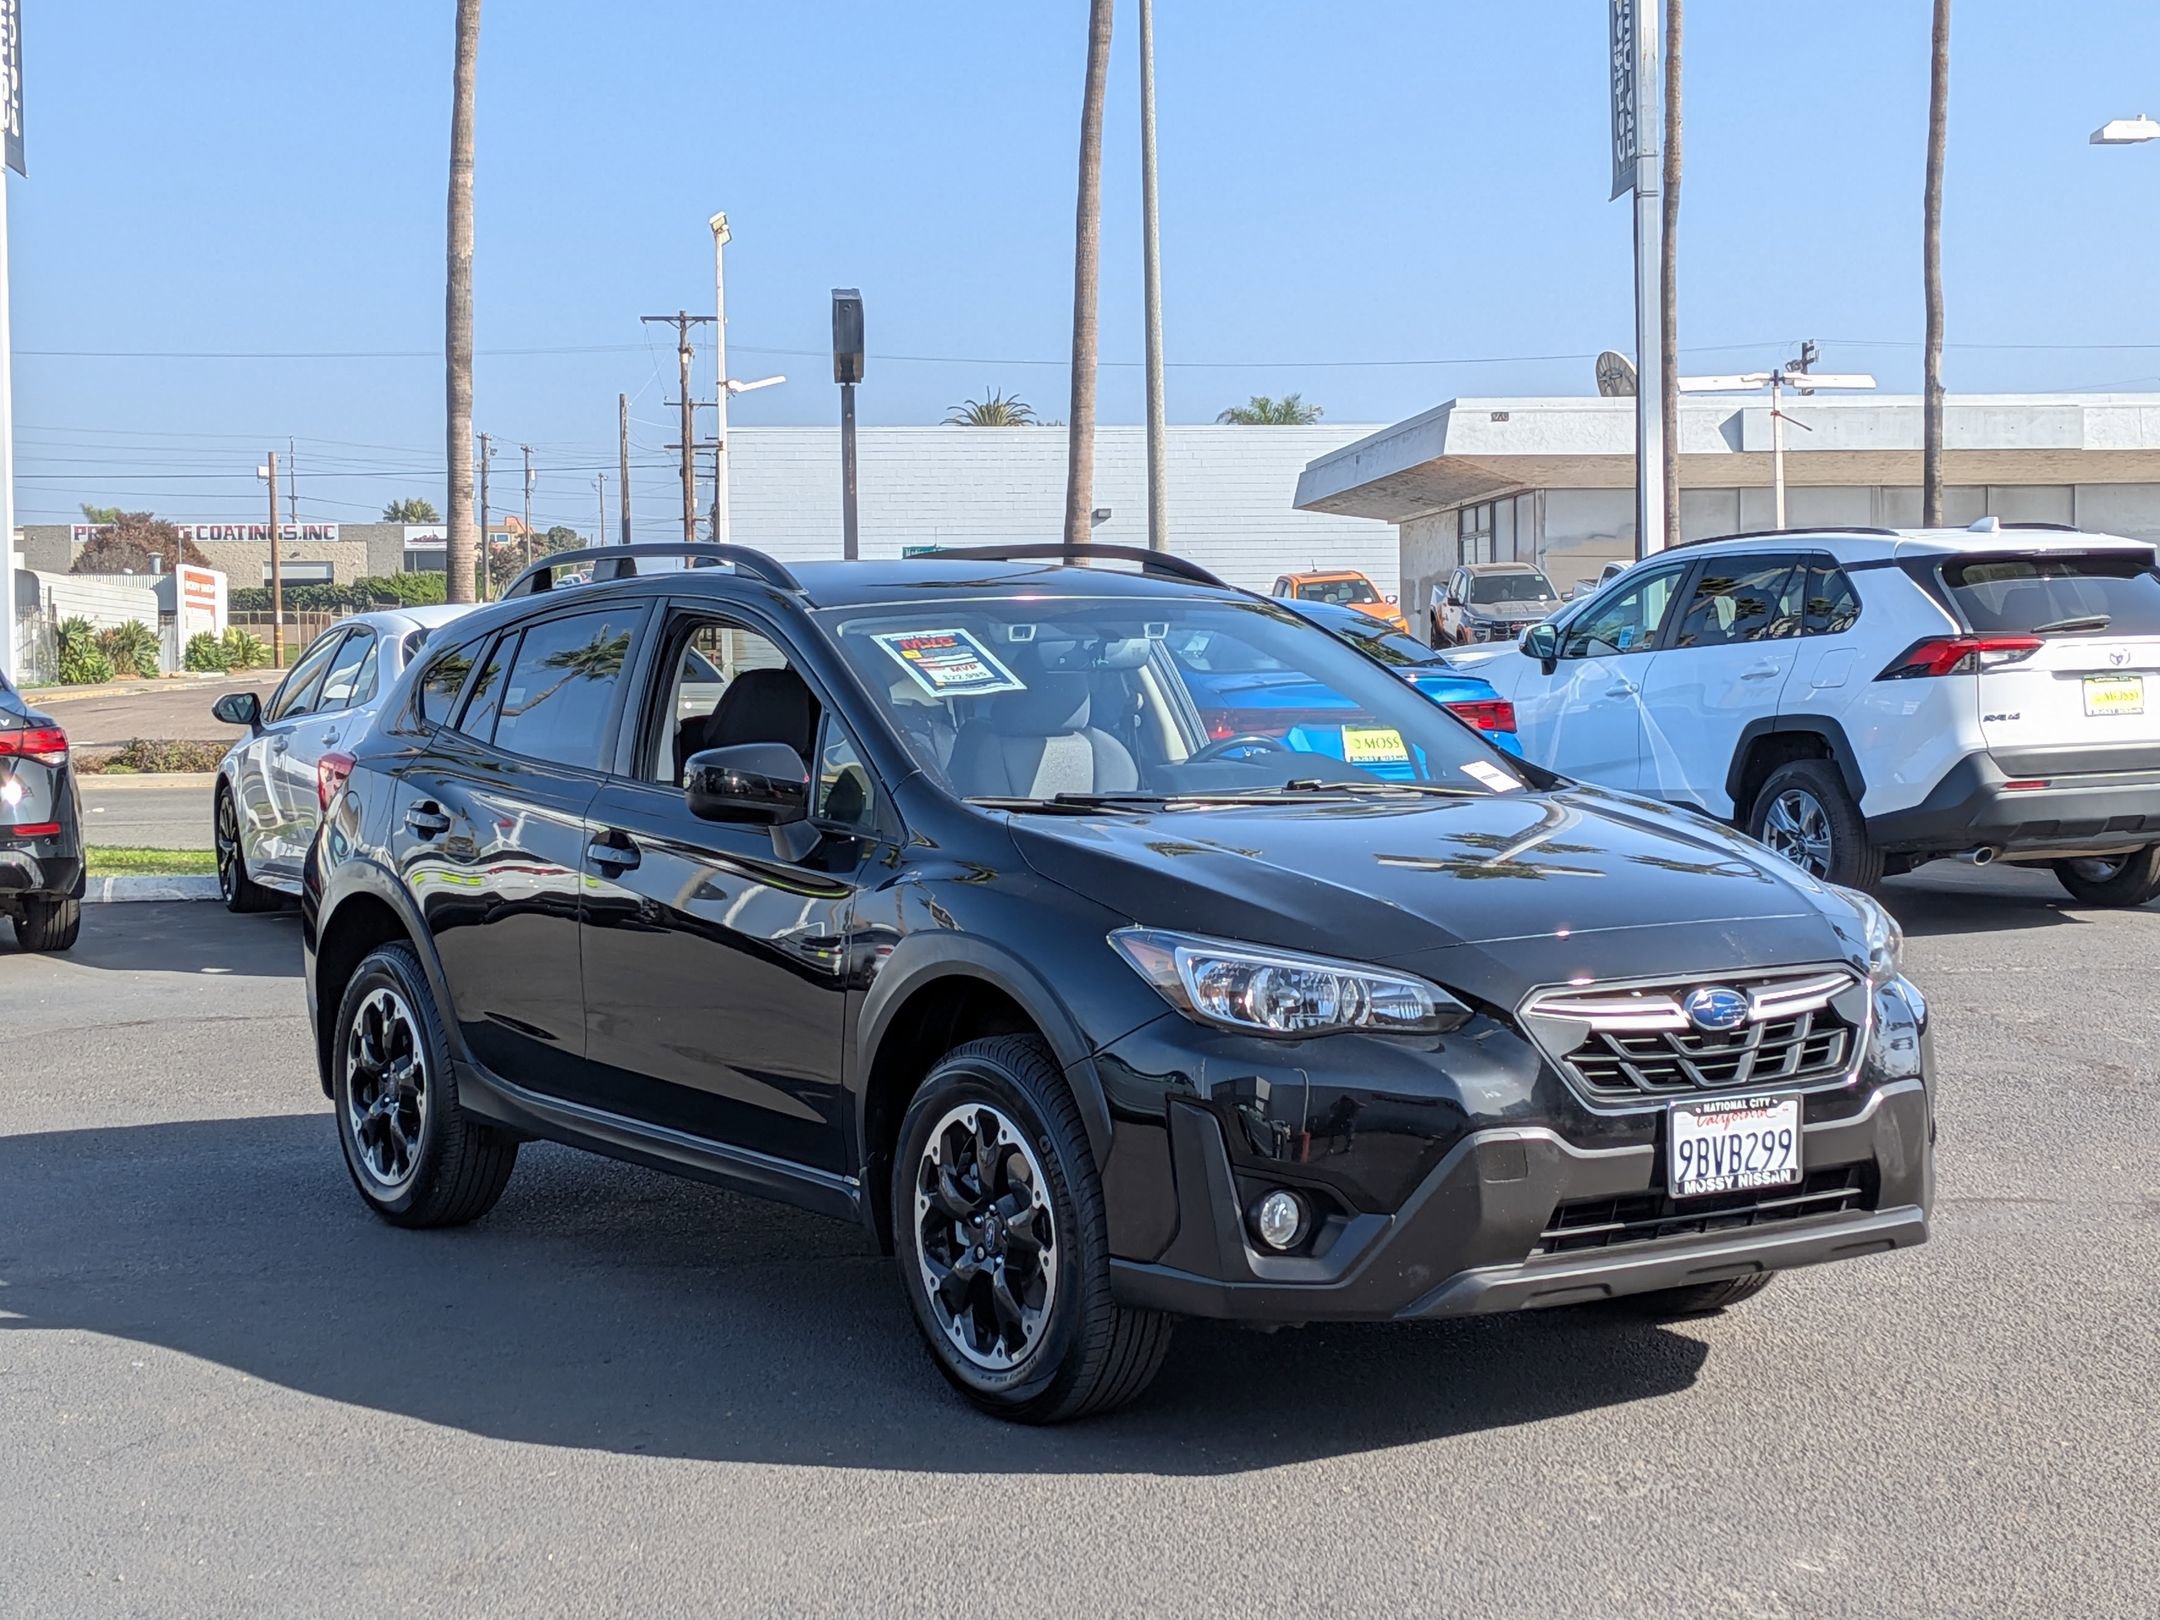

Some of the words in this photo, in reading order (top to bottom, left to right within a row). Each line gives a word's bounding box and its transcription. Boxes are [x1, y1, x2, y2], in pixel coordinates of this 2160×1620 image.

[1703, 1099, 1747, 1113] NATIONAL
[1749, 1097, 1772, 1108] CITY
[1678, 1128, 1792, 1181] 9BVB299
[1684, 1175, 1735, 1195] MOSSY
[1737, 1169, 1792, 1187] NISSAN
